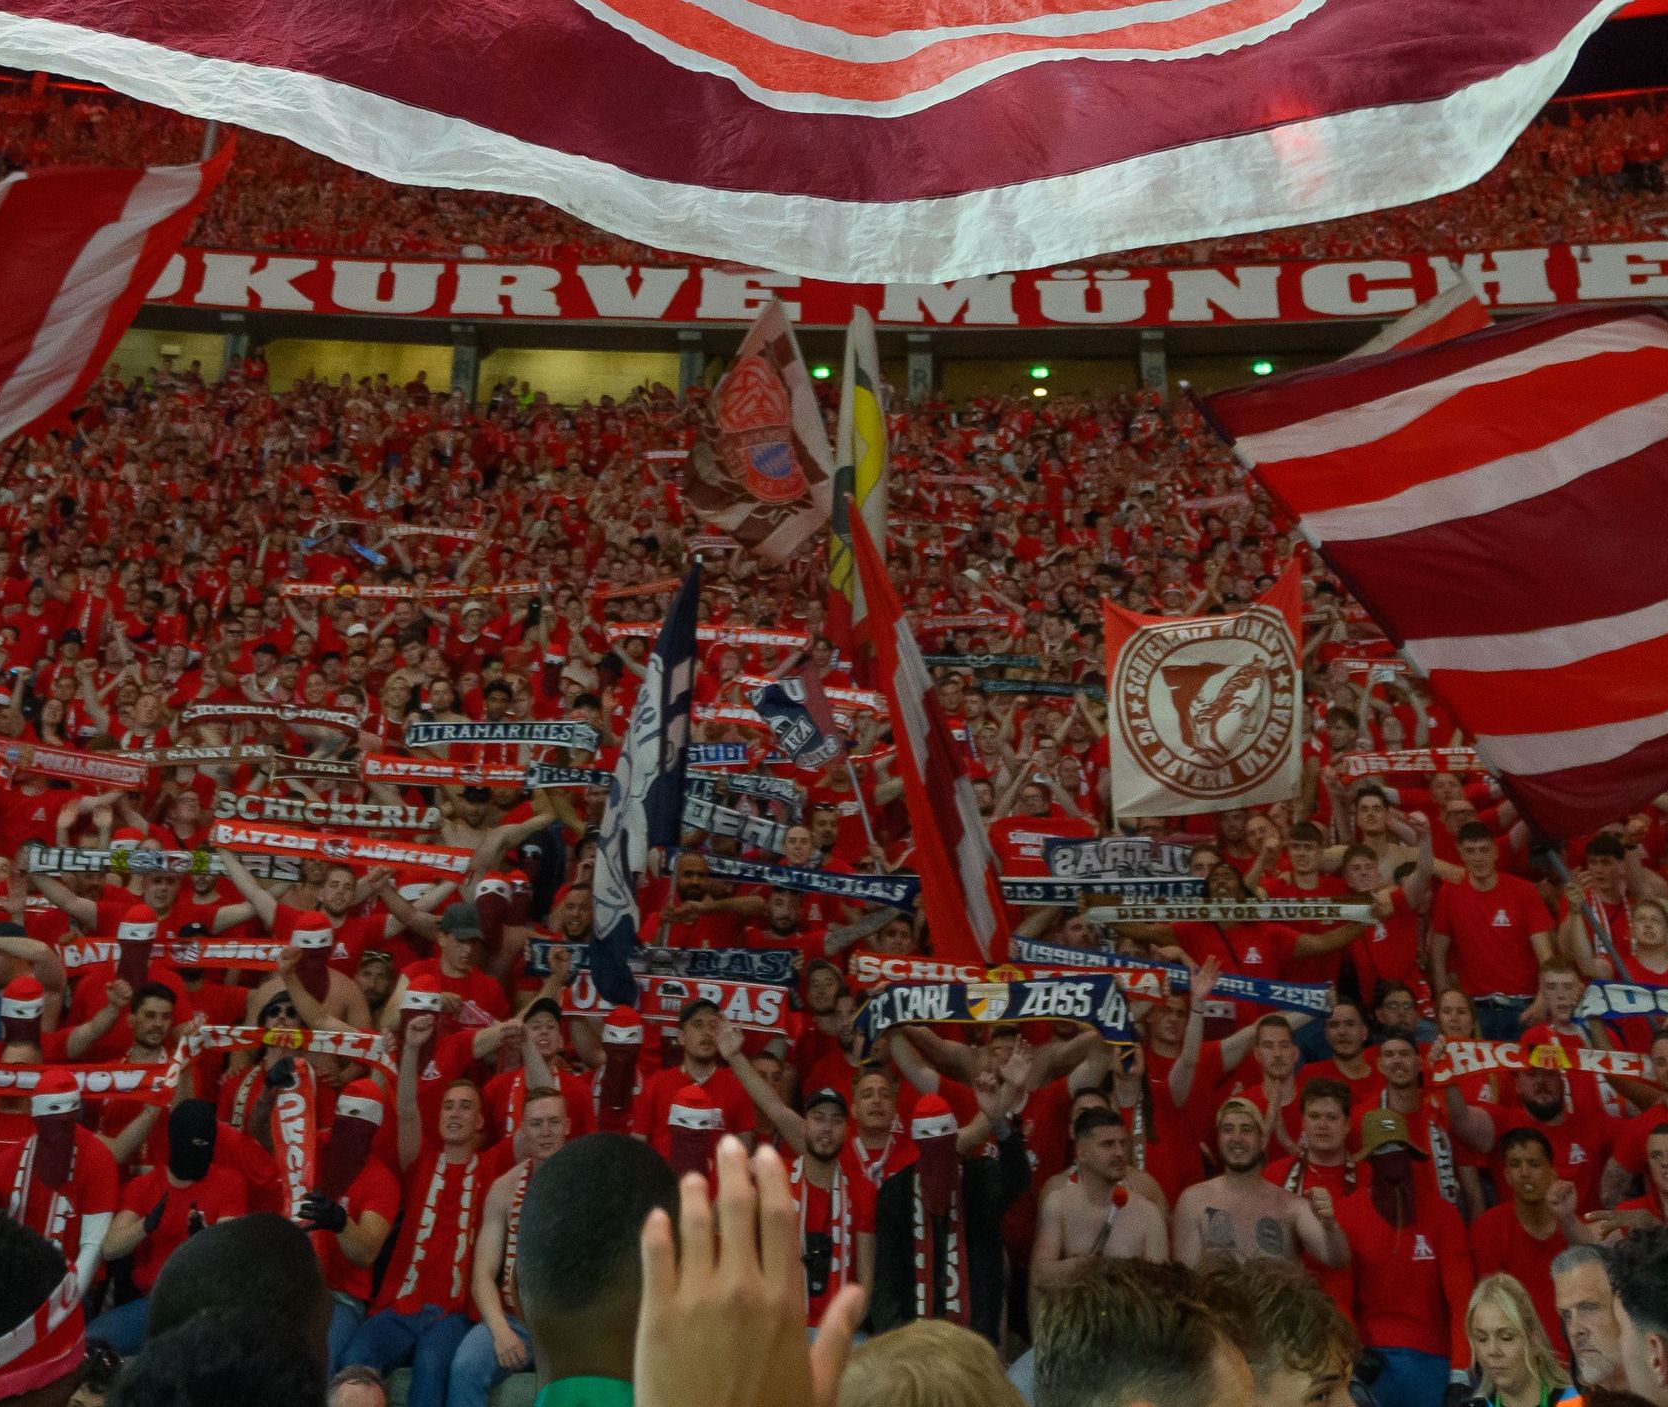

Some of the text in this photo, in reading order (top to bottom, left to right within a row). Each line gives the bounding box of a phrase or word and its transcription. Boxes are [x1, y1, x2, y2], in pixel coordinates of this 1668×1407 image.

[214, 790, 442, 831] SCHICKERIA
[1165, 907, 1216, 921] SIEG
[1221, 907, 1262, 921] VOR
[1269, 906, 1342, 920] AUGEN
[857, 955, 982, 984] SCHIC
[696, 983, 783, 1026] RAS
[893, 983, 956, 1023] CARL
[1018, 981, 1096, 1017] ZEISS
